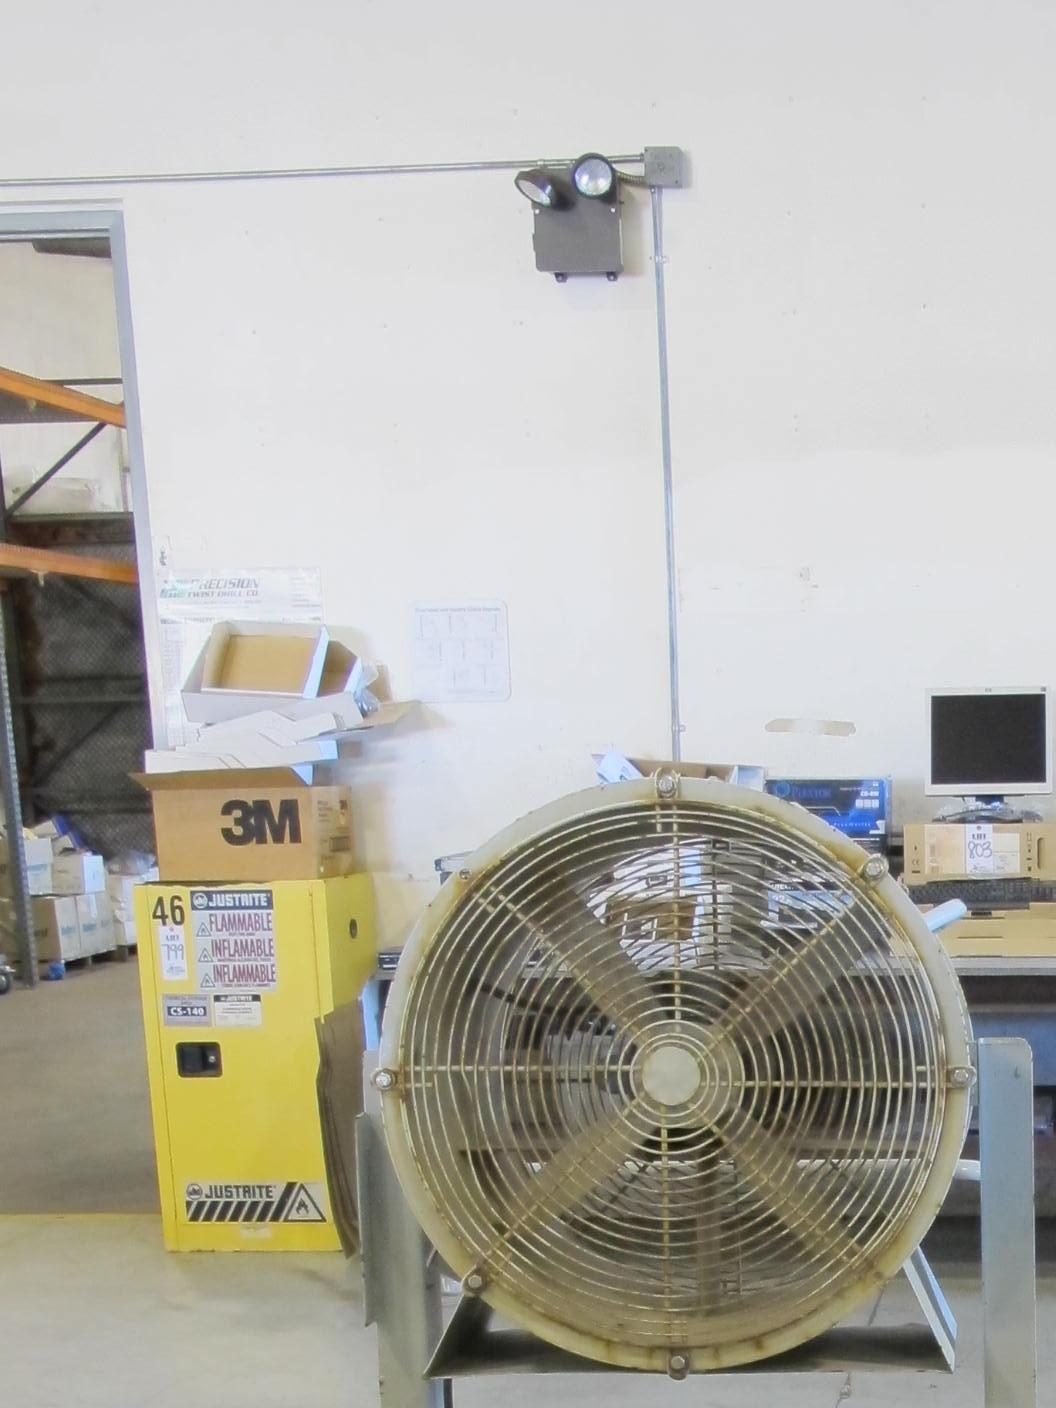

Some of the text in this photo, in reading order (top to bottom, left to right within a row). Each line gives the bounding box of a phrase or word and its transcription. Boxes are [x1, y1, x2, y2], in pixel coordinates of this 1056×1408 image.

[220, 799, 302, 846] 3M
[968, 841, 992, 859] 803
[208, 893, 268, 908] JUSTRITE
[152, 895, 185, 927] 46
[209, 912, 273, 932] FLAMMABLE
[161, 944, 184, 960] 799
[211, 938, 274, 958] INFLAMABLE
[213, 963, 276, 983] INFLAMMABLE
[170, 1007, 205, 1016] CS-140
[205, 1185, 275, 1199] JUSTRITE
